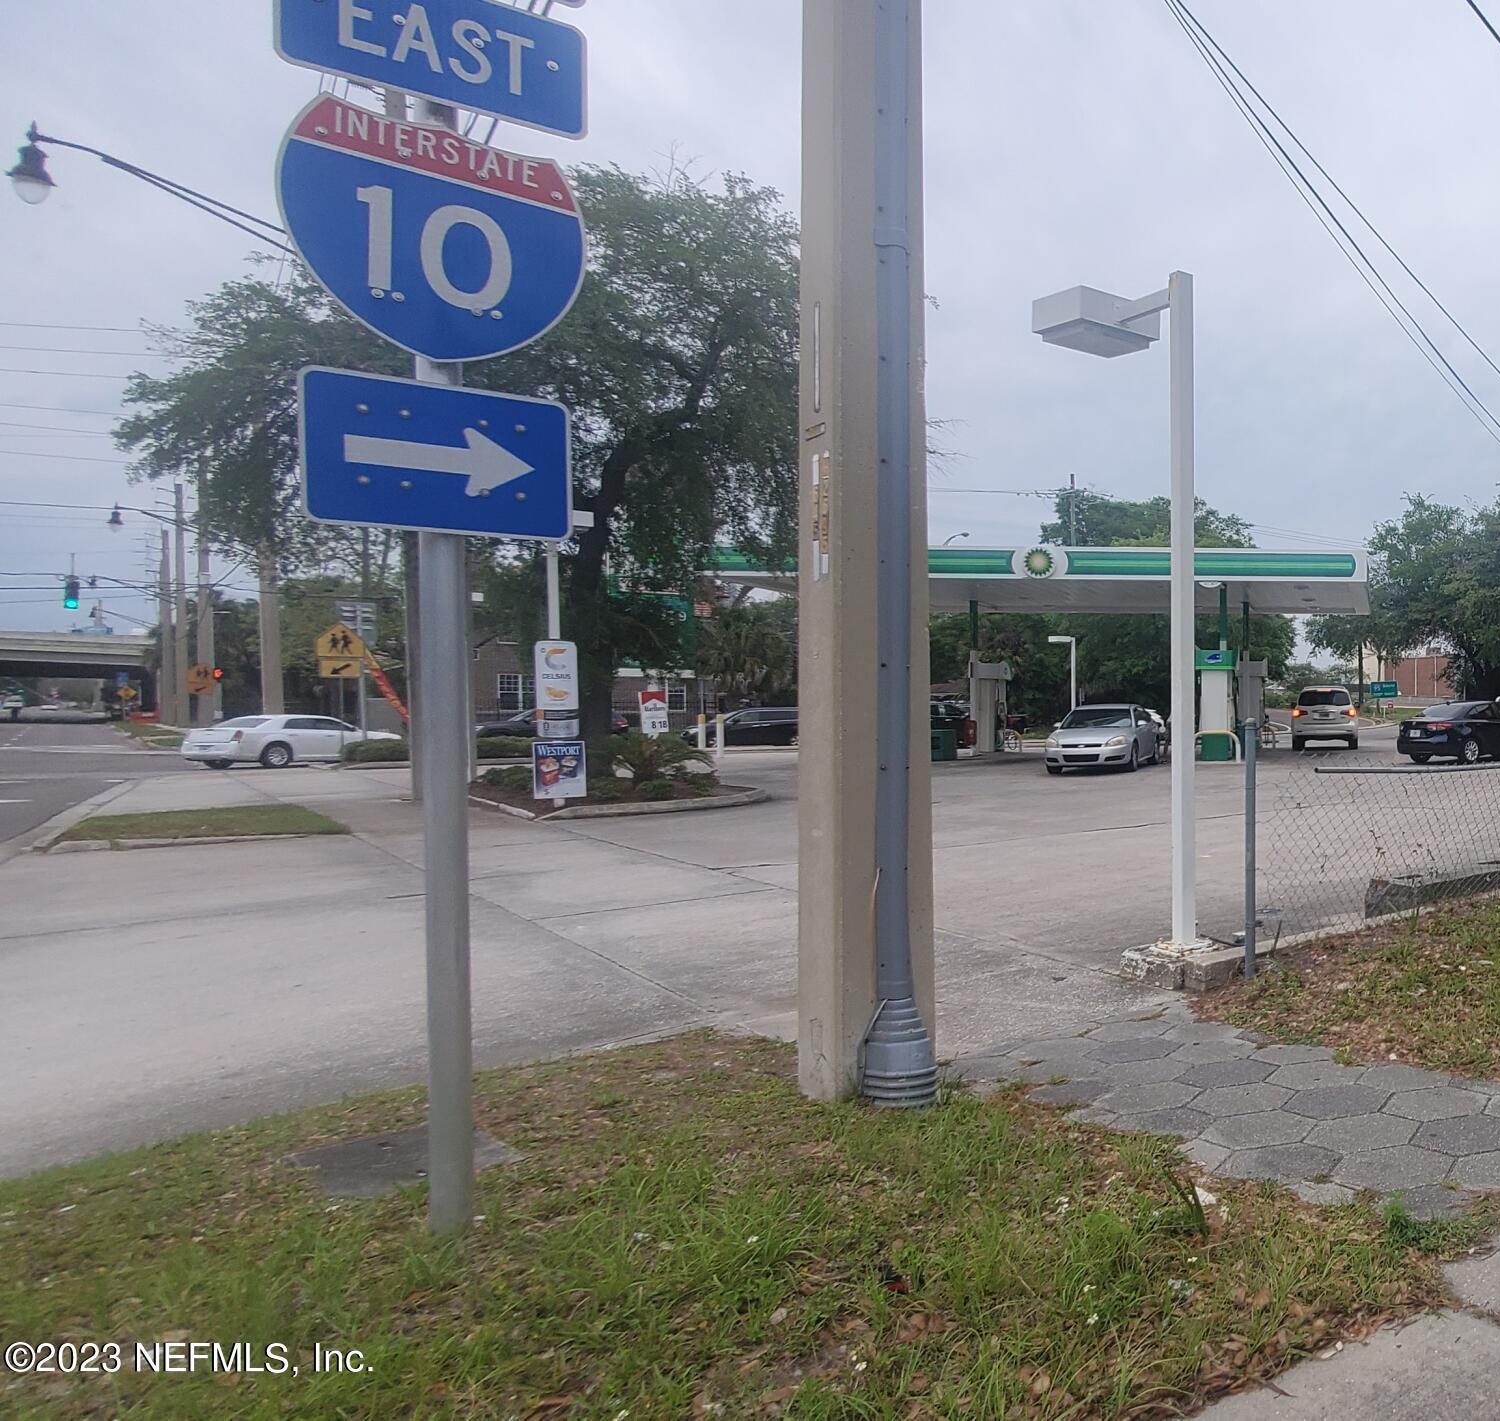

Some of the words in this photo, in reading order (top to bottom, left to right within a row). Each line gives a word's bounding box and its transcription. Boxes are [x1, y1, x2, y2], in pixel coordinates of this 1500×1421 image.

[338, 0, 535, 96] EAST
[335, 106, 539, 188] INTERSTATE
[356, 185, 513, 311] 10
[537, 744, 581, 756] WESTPORT
